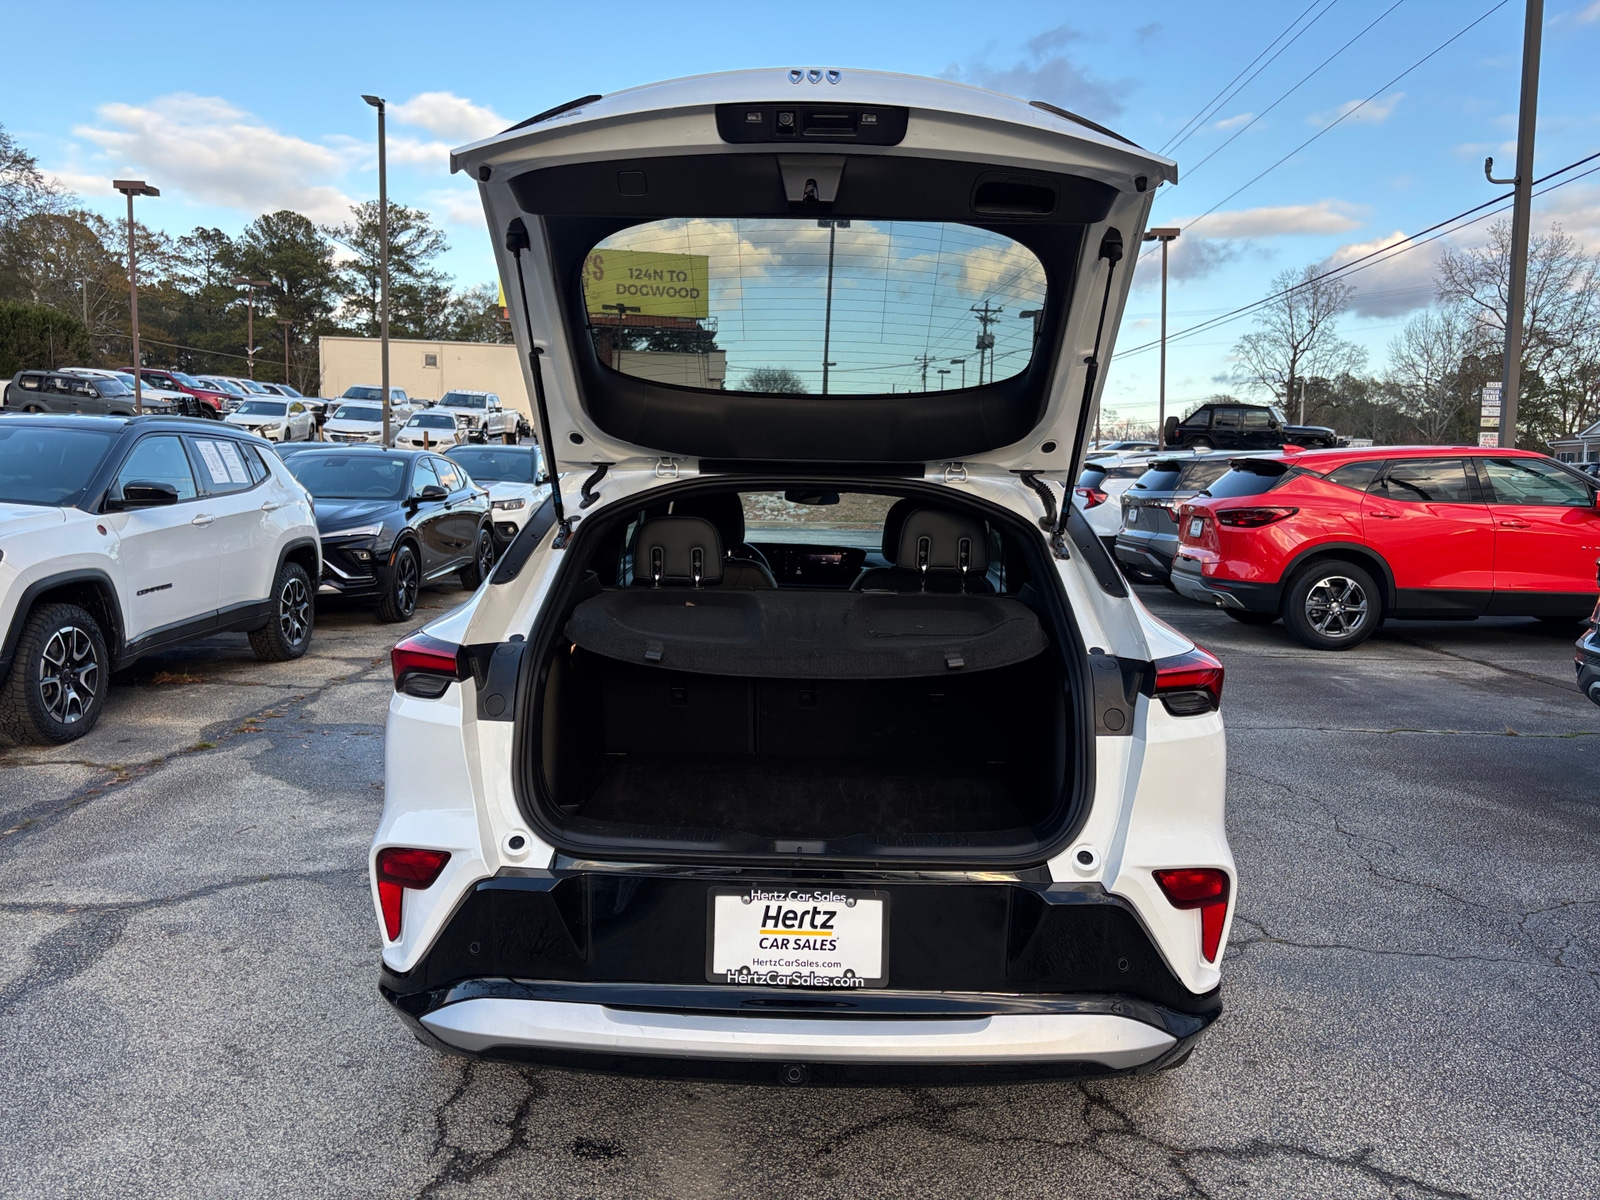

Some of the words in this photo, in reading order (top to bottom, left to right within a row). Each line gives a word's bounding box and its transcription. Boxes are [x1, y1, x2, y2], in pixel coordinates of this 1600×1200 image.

[628, 268, 663, 281] 124N
[667, 270, 687, 282] TO
[616, 284, 700, 299] DOGWOOD
[751, 890, 785, 901] Hertz
[788, 891, 811, 902] Car
[813, 892, 846, 903] Sales
[761, 905, 837, 930] Hertz
[759, 938, 789, 950] CAR
[792, 939, 837, 951] SALES
[752, 958, 842, 968] HertzCarSales.com
[727, 969, 864, 987] HertzCarSales.com
